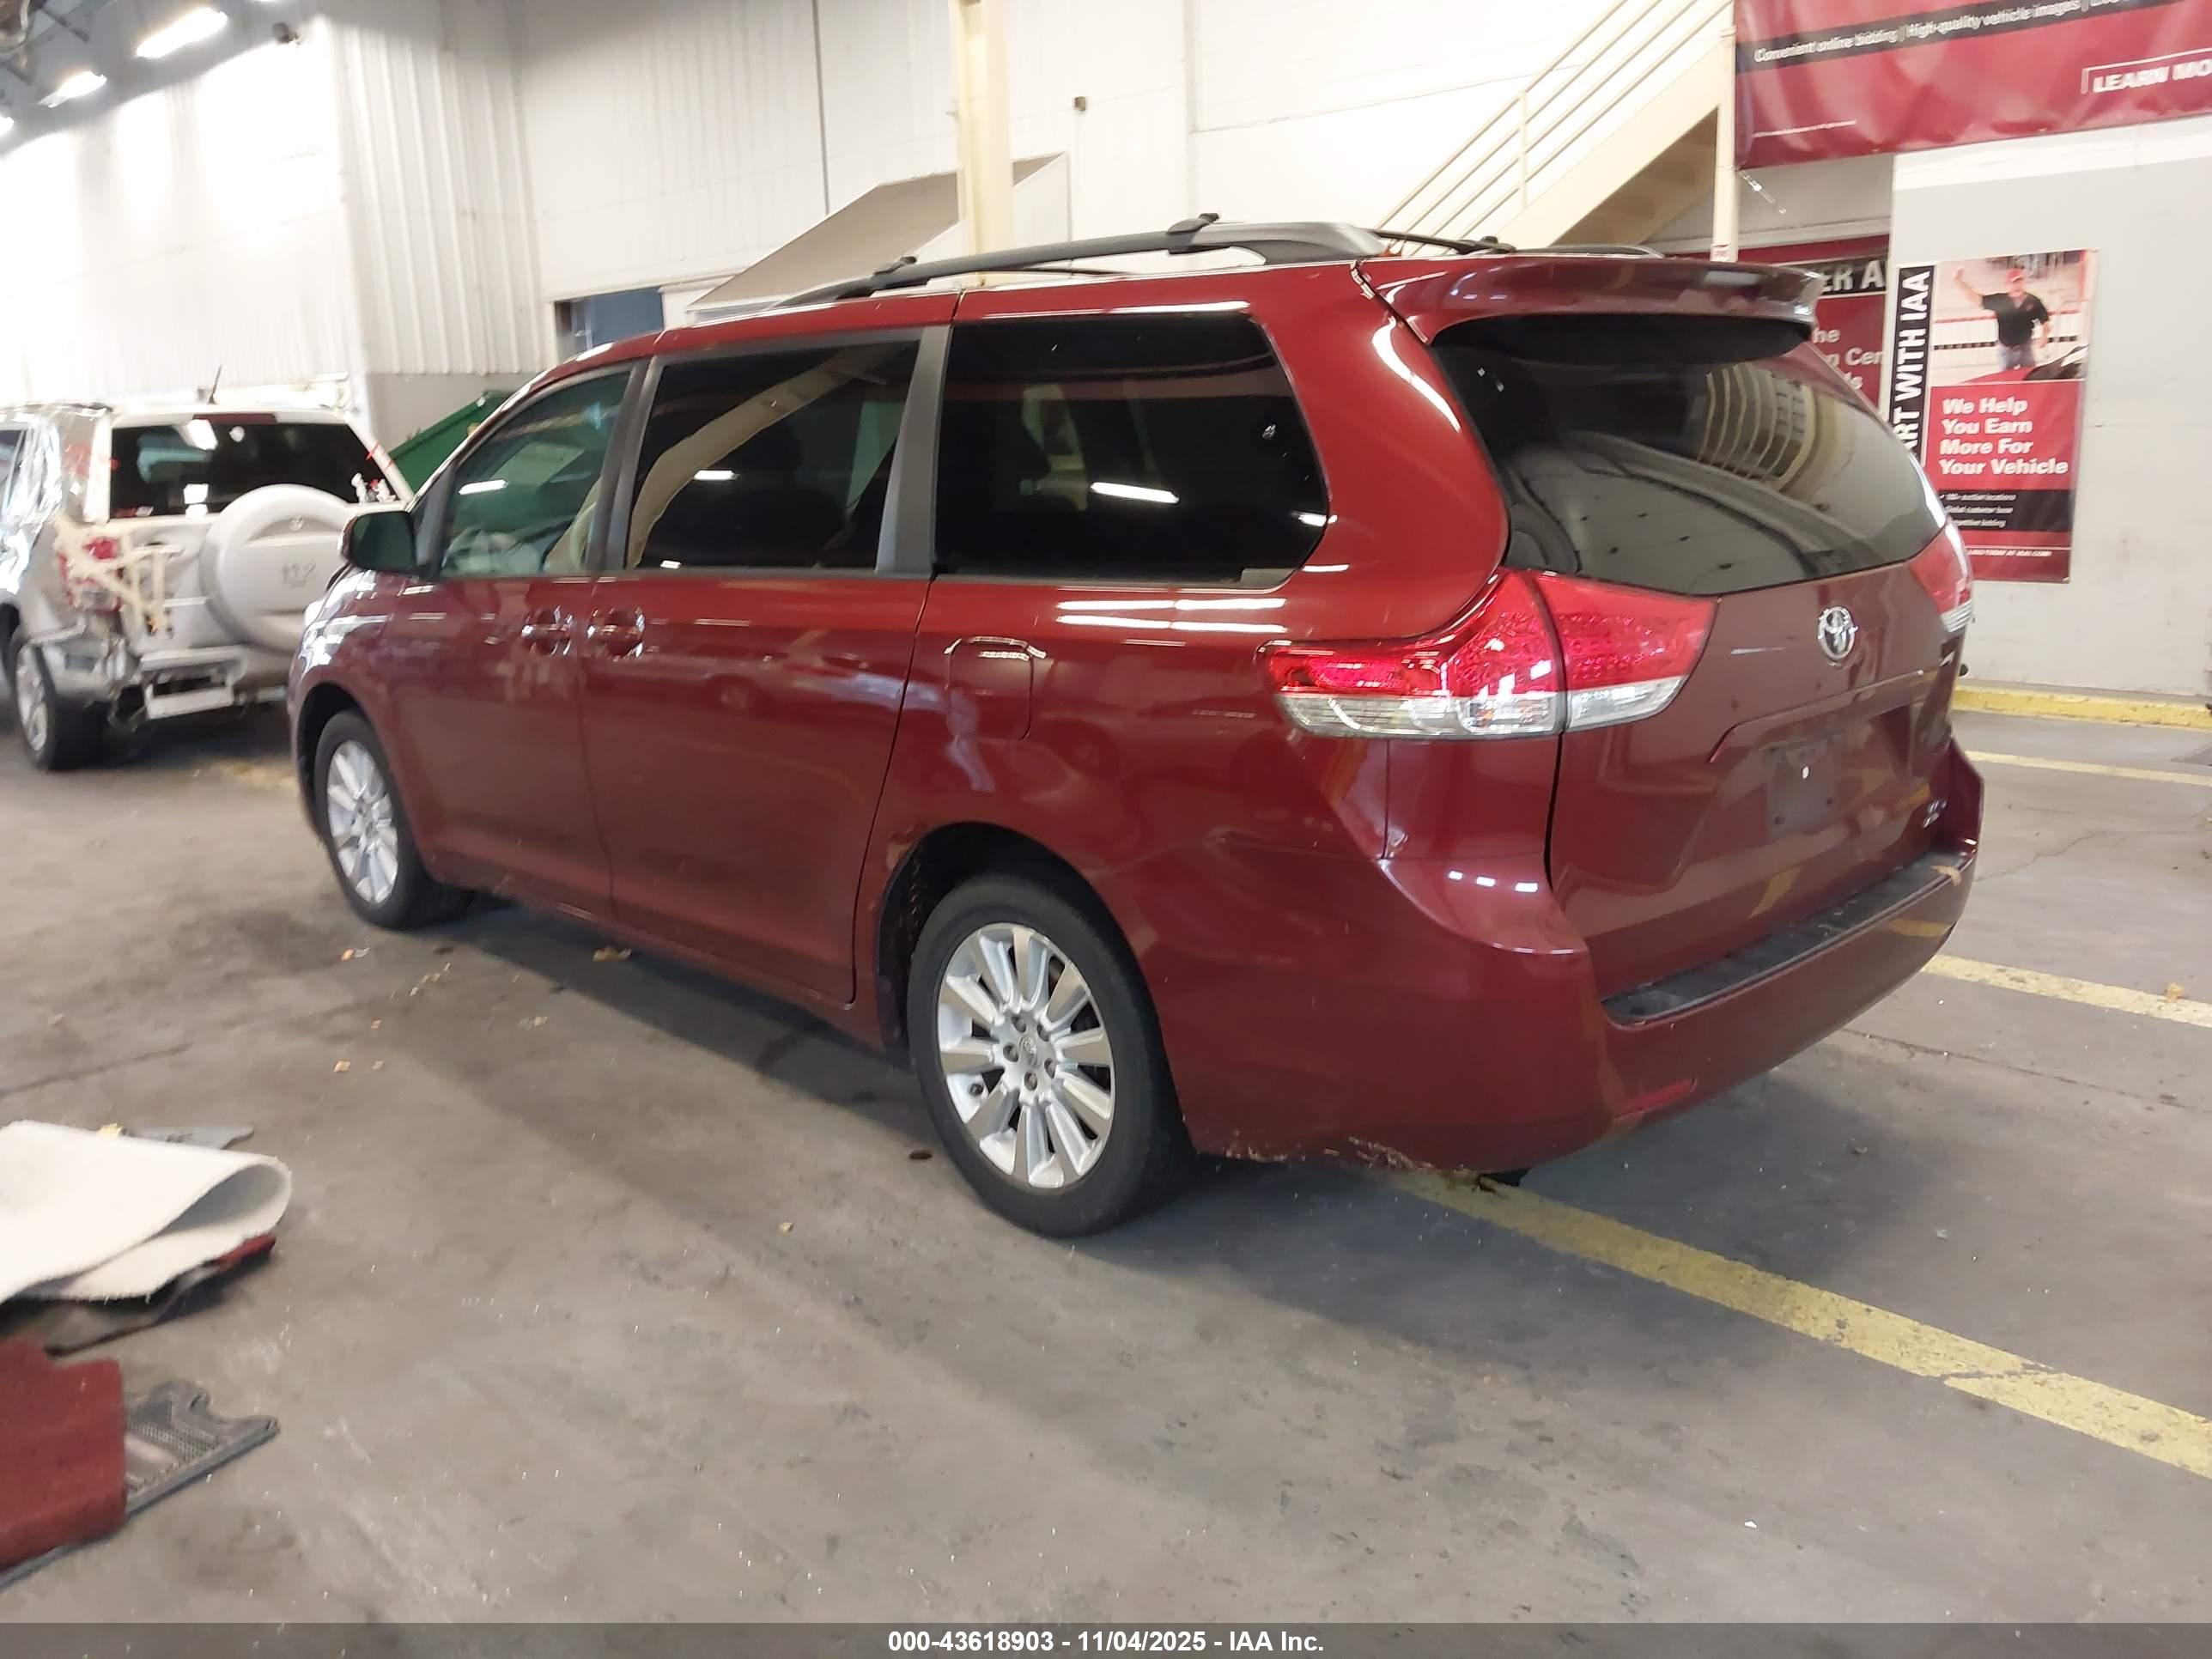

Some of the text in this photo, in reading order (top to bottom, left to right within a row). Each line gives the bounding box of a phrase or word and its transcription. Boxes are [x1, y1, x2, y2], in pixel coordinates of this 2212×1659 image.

[2093, 66, 2170, 93] LEARN
[1899, 270, 1931, 321] IAA
[1895, 329, 1926, 402] WITH
[1942, 397, 2028, 416] We Help
[1942, 417, 2033, 434] You Earn
[1939, 438, 2033, 455] More For
[1938, 458, 2069, 475] Your Vehicle
